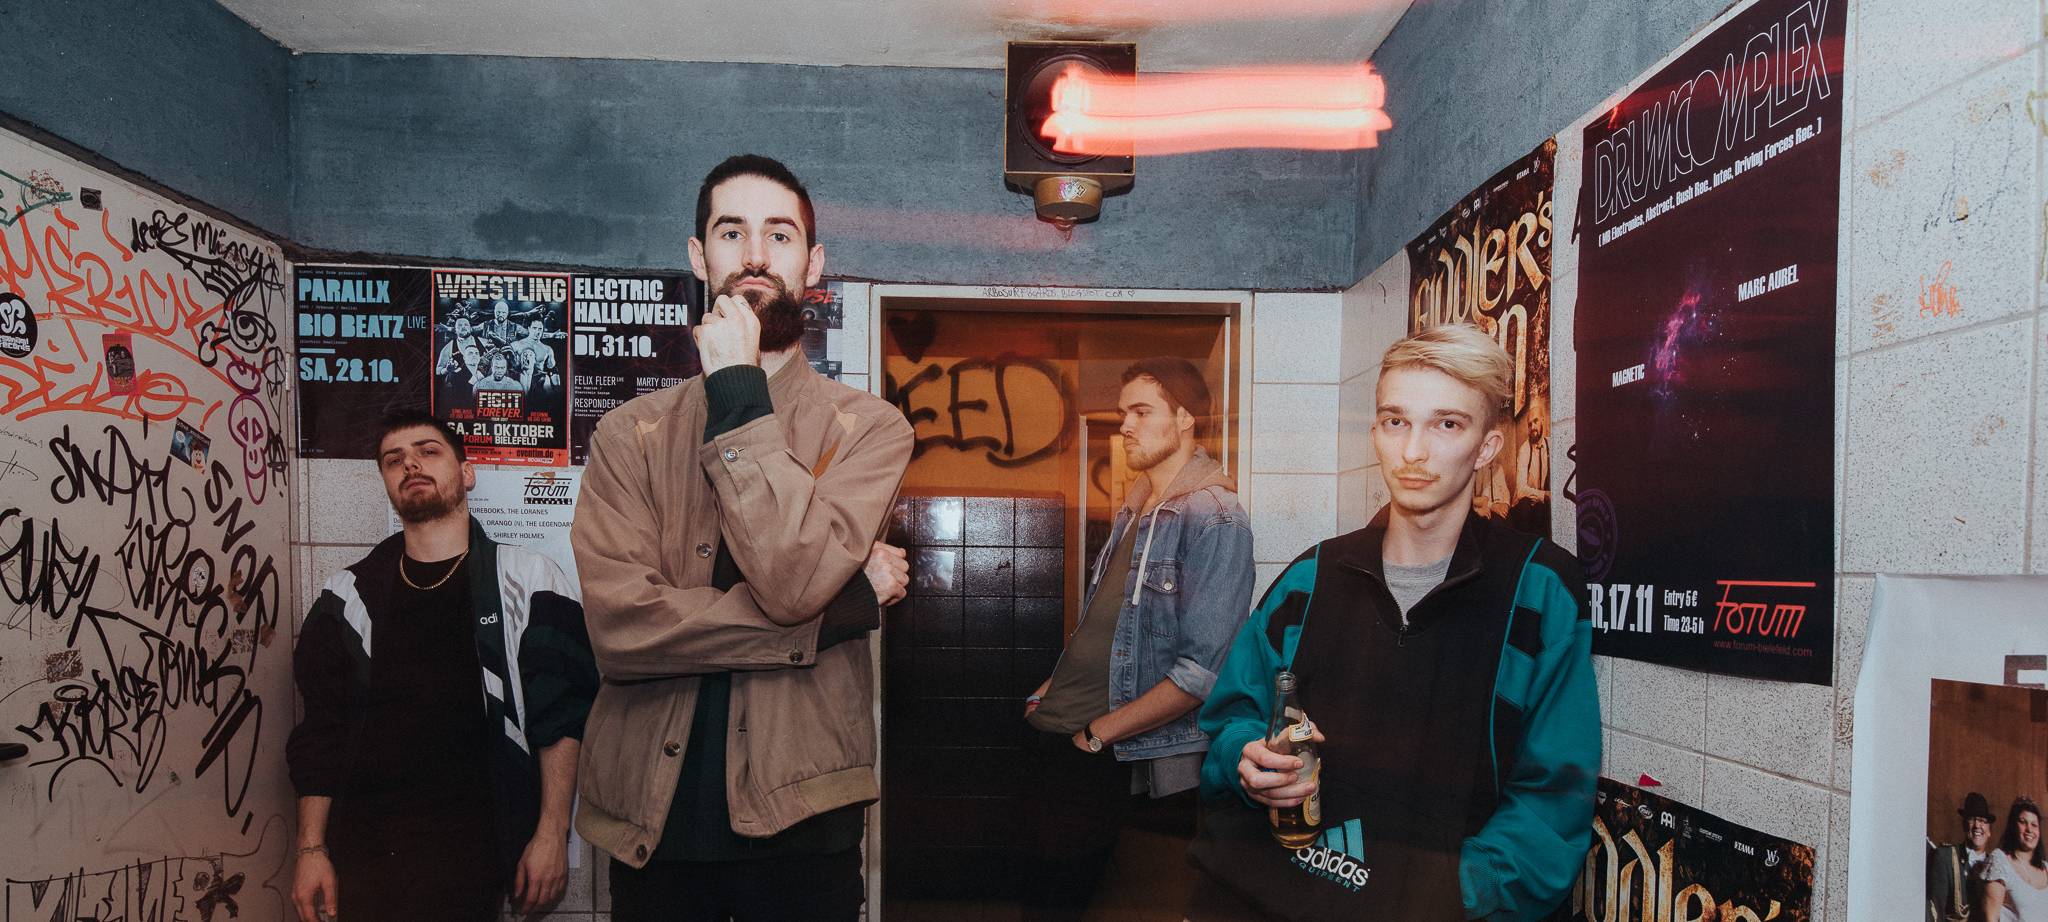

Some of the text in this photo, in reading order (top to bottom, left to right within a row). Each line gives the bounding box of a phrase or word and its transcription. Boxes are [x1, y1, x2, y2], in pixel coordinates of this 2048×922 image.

[1596, 0, 1831, 224] DRUMCOMPLEX
[1645, 196, 1675, 222] Abstract,
[1676, 186, 1693, 206] Bush
[1694, 179, 1712, 197] Rec.,
[1713, 167, 1734, 187] Intec,
[1735, 150, 1763, 176] Driving
[1764, 134, 1794, 160] Forces
[1795, 124, 1815, 145] Rec.
[299, 278, 391, 303] PARALLX
[436, 273, 567, 302] WRESTLING
[574, 277, 664, 302] ELECTRIC
[1738, 264, 1799, 302] MARC AUREL
[574, 301, 688, 326] HALLOWEEN
[299, 313, 426, 338] BIO BEATZ LIVE
[574, 376, 594, 386] FELIX
[595, 376, 617, 386] FLEER
[636, 377, 660, 387] MARTY
[1612, 363, 1645, 388] MAGNETIC
[478, 391, 522, 408] FIGHT
[574, 398, 617, 409] RESPONDER
[885, 352, 1075, 468] EED
[463, 434, 538, 446] FORUM BIELEFELD
[473, 423, 490, 435] 21.
[493, 424, 555, 438] OKTOBER
[493, 532, 518, 540] SHIRLEY
[519, 532, 545, 540] HOLMES
[539, 521, 573, 529] LEGENDARY
[1664, 589, 1684, 609] Entry
[1664, 614, 1704, 634] Time 23-5 h
[1713, 639, 1813, 657] www.forum-bielefeld.com
[1296, 847, 1369, 887] adidas
